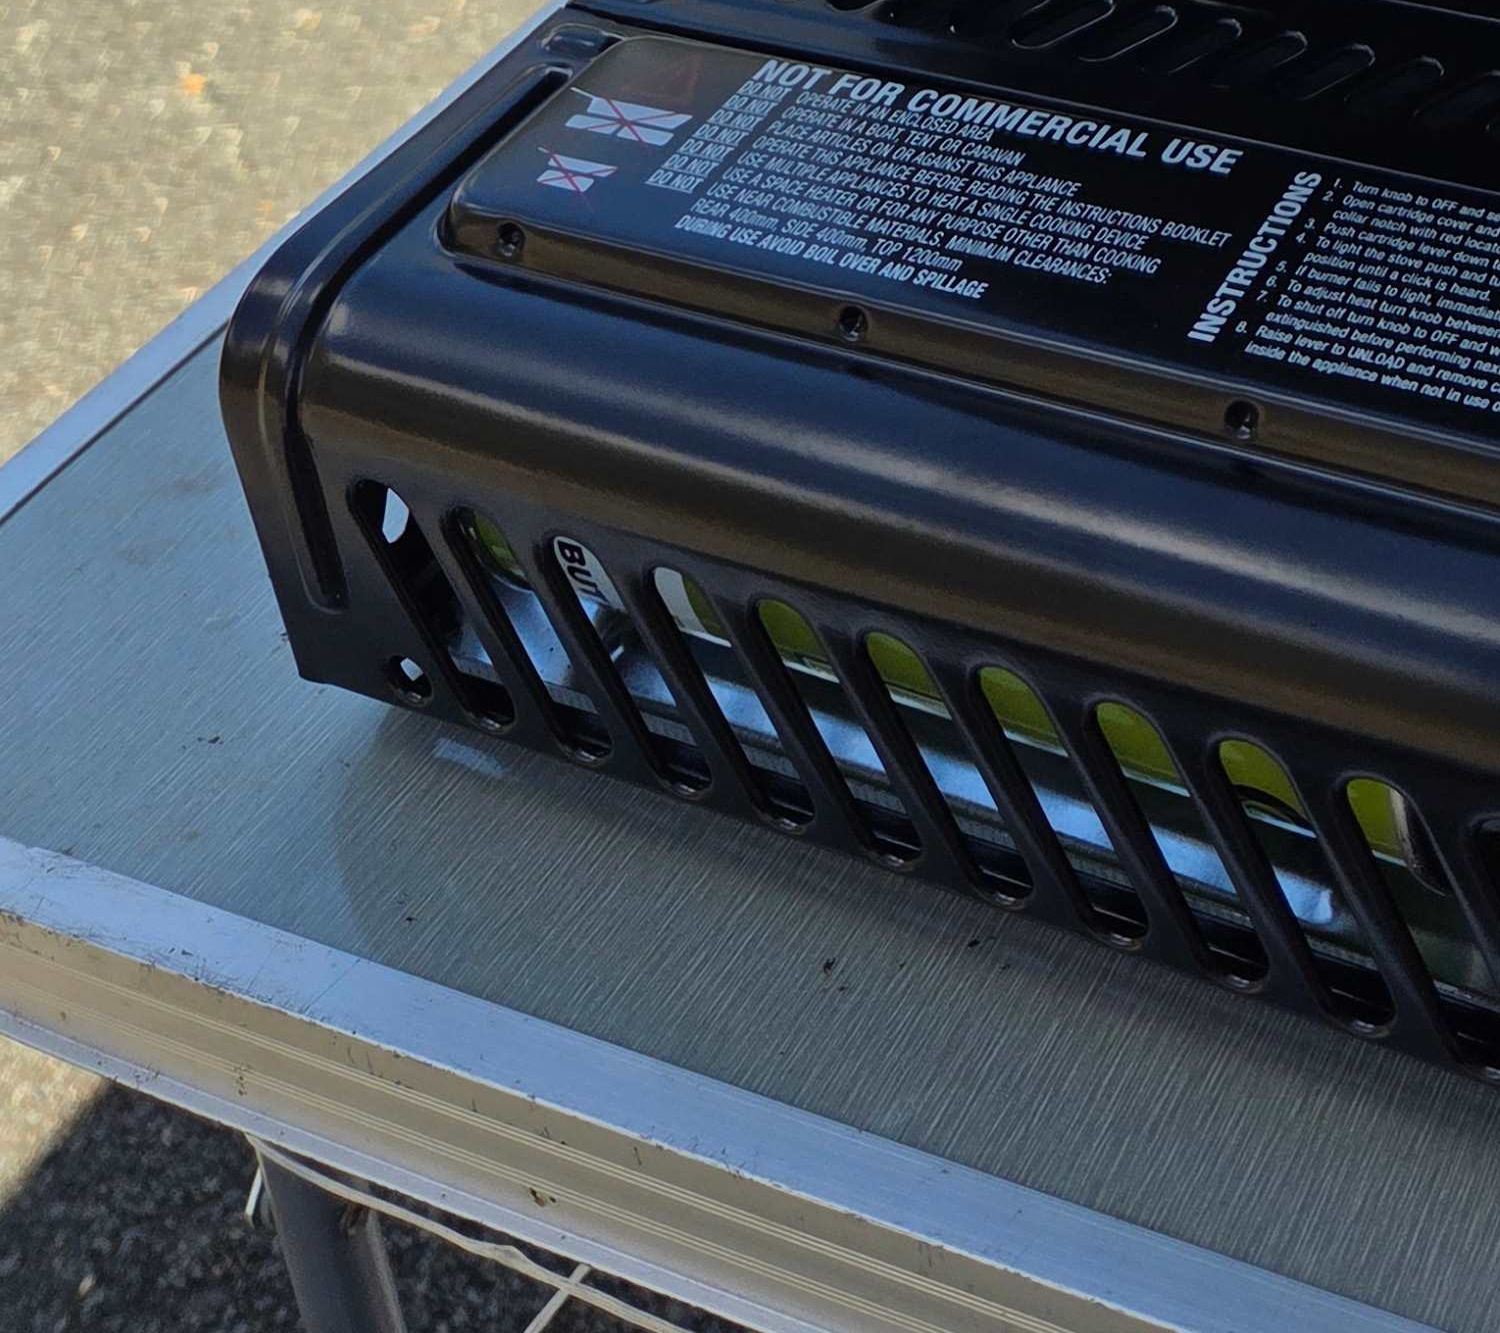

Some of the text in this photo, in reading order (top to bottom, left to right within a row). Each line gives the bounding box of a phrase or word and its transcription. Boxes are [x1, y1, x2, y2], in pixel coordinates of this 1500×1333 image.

[725, 94, 749, 107] DO
[746, 99, 778, 113] NOT
[782, 106, 841, 127] OPERATE
[838, 118, 858, 131] IN
[852, 120, 867, 134] A
[904, 130, 942, 148] TENT
[939, 138, 963, 153] OR
[961, 142, 1025, 166] CARAVAN
[739, 80, 994, 142] DO NOT OPERATE IN AN ENCLOSED AREA
[753, 60, 1242, 173] NOT FOR COMMERCIAL USE
[694, 124, 1231, 246] DO NOT OPERATE THIS APPLIANCE BEFORE READING THE INSTRUCTIONS BOOKLET
[710, 109, 1081, 196] DO NOT PLACE ARTICLES ON OR AGAINST THIS APPLIANCE
[648, 169, 673, 184] DO
[670, 174, 704, 191] NOT
[707, 182, 739, 199] USE
[734, 189, 774, 207] NEAR
[773, 197, 868, 229] COMBUSTIBLE
[945, 235, 1015, 261] MINIMUM
[1014, 251, 1111, 283] CLEARANCES:
[664, 154, 1161, 273] DO NOT USE A SPACE HEATER OR FOR ANY PURPOSE OTHER THAN COOKING
[679, 139, 1149, 250] DO NOT USE MULTIPLE APPLIANCES TO HEAT A SINGLE COOKING DEVICE
[1322, 190, 1334, 201] 2.
[1343, 195, 1375, 210] Open
[1377, 204, 1434, 223] cartridge
[1437, 217, 1473, 231] cover
[1475, 225, 1500, 237] and
[1353, 181, 1379, 195] Turn
[1381, 188, 1413, 202] knob
[1415, 195, 1429, 206] to
[1432, 198, 1458, 211] OFF
[1459, 206, 1485, 218] and
[675, 215, 988, 298] DURING USE AVOID BOIL OVER AND SPILLAGE
[691, 198, 730, 217] REAR
[781, 219, 819, 238] SIDE
[871, 238, 903, 256] TOP
[902, 246, 963, 271] 1200mm
[1187, 171, 1323, 344] INSTRUCTIONS
[1304, 218, 1315, 229] 3.
[1324, 222, 1355, 237] Push
[1358, 231, 1415, 251] cartridge
[1418, 242, 1451, 258] lever
[1453, 251, 1489, 267] down
[1266, 275, 1277, 287] 6.
[1287, 279, 1302, 292] To
[1304, 286, 1345, 302] adjust
[1346, 293, 1378, 309] heat
[1379, 301, 1407, 316] turn
[1409, 308, 1442, 324] knob
[1256, 325, 1293, 343] Raise
[1294, 334, 1329, 351] lever
[1330, 343, 1345, 355] to
[1348, 346, 1405, 369] UNLOAD
[1406, 362, 1435, 376] and
[1436, 369, 1488, 389] remove
